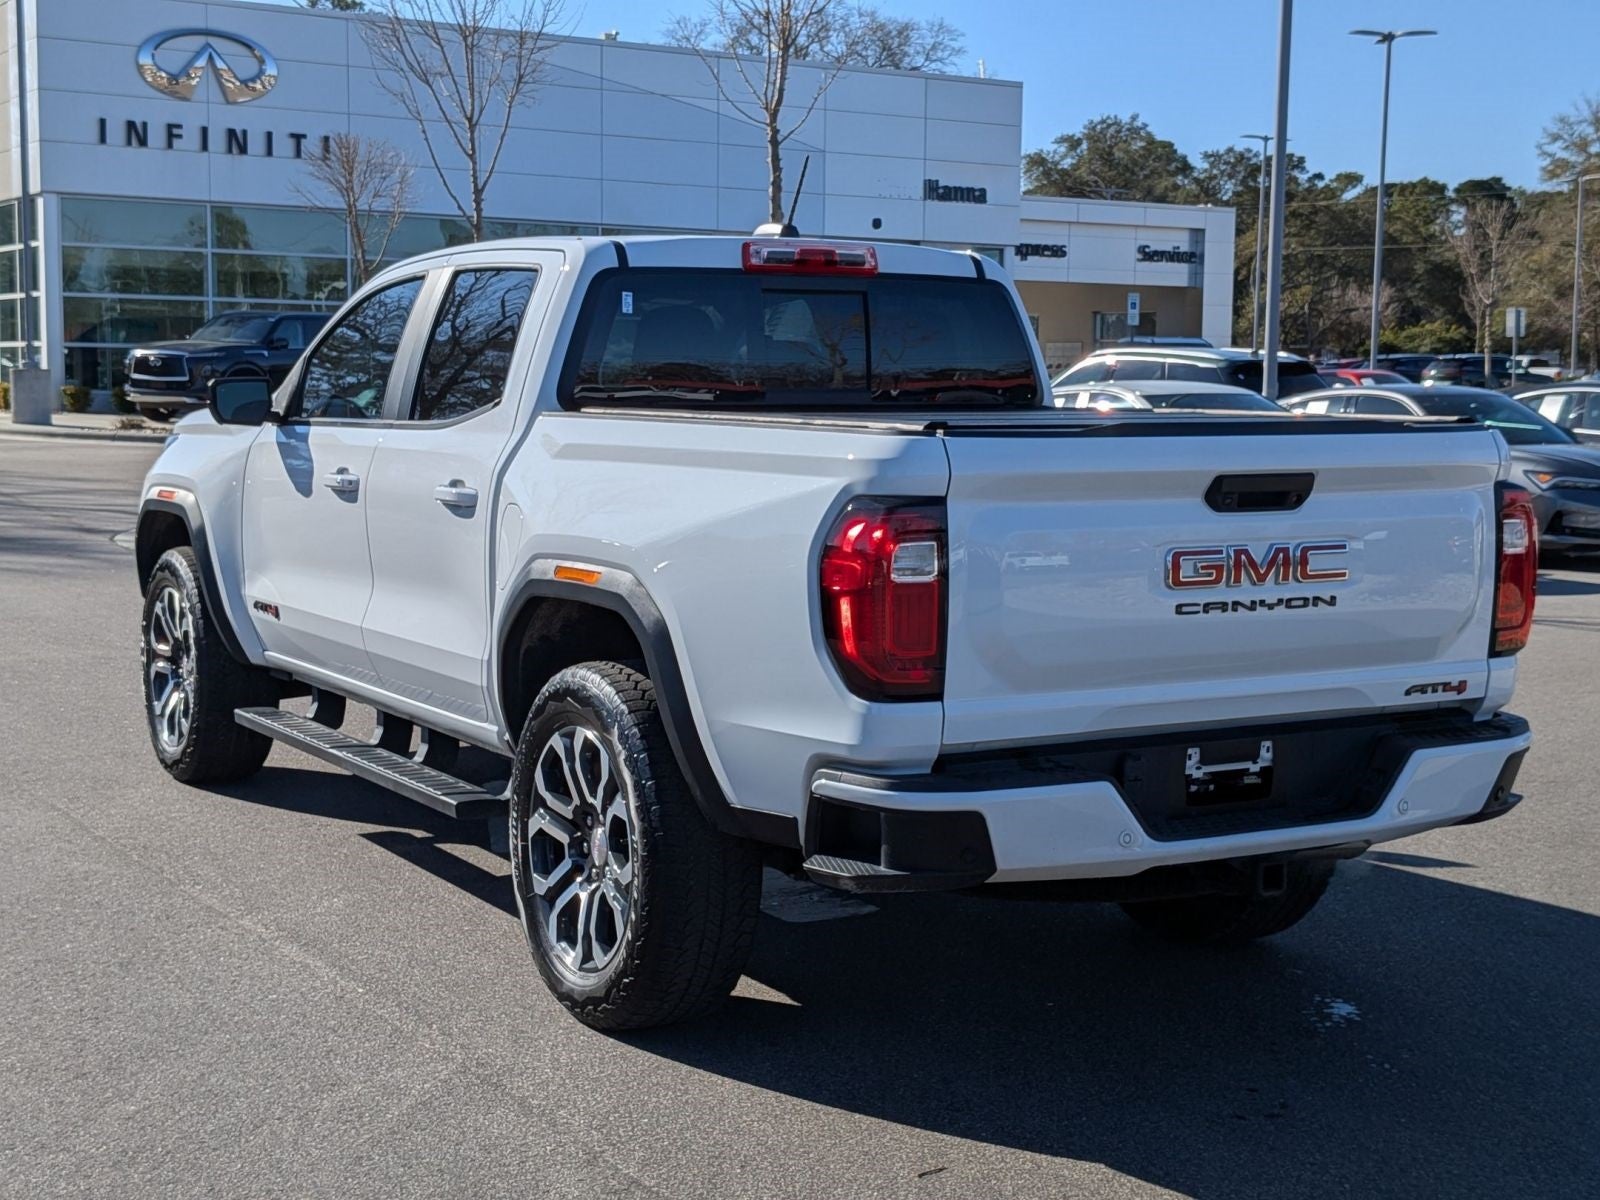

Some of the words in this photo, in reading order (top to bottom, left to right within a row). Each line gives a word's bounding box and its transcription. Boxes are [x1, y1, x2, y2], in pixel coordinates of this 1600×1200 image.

[99, 118, 331, 160] INFINITI
[1014, 243, 1067, 261] xpress
[1136, 245, 1197, 264] Service
[1164, 540, 1348, 590] GMC
[1174, 595, 1337, 616] CANYON
[1404, 680, 1467, 696] AT4
